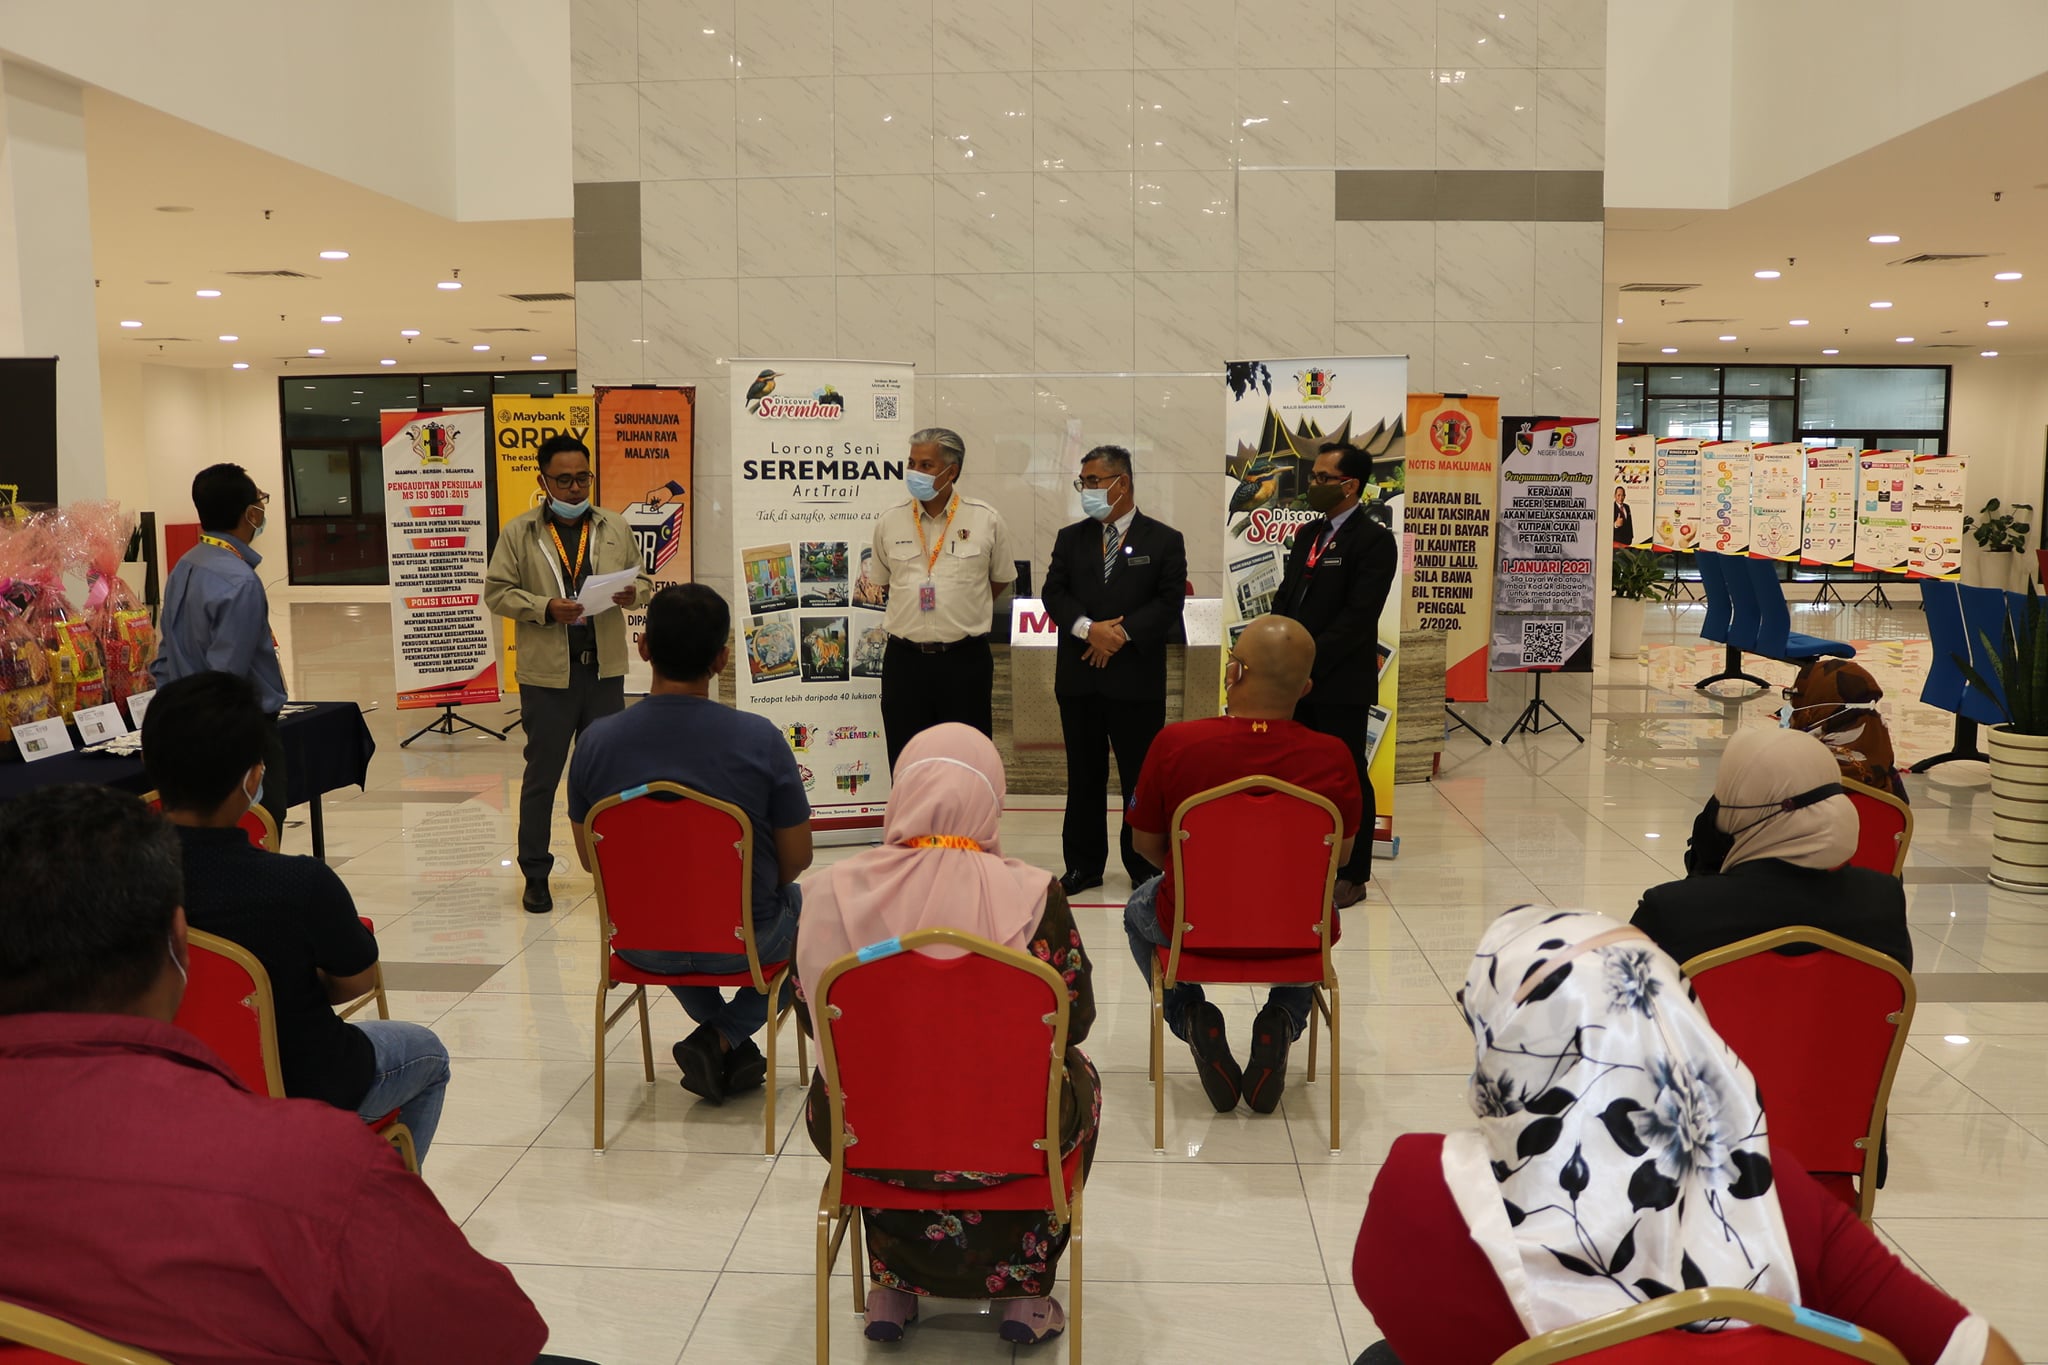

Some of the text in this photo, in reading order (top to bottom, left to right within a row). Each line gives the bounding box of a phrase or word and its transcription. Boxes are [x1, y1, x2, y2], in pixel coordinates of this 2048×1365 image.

[759, 398, 840, 419] Seremban
[513, 412, 565, 423] Maybank
[615, 414, 679, 425] SURUHANJAYA
[617, 431, 677, 442] PILIHAN RAYA
[625, 448, 669, 459] MALAYSIA
[771, 441, 880, 458] Lorong Seni
[743, 460, 903, 480] SEREMBAN
[1409, 460, 1491, 472] NOTIS MAKLUMAN
[1505, 471, 1593, 485] Pengumuman Penting
[1819, 478, 1824, 489] 1
[388, 481, 482, 491] PENGAUDITAN PENSIJILAN
[1528, 487, 1570, 496] KERAJAAN
[403, 490, 468, 499] MS ISO 9001:2015
[1413, 491, 1481, 505] BAYARAN BIL
[1806, 492, 1837, 503] 2 3
[1513, 500, 1584, 508] NEGERI SEMBILAN
[756, 509, 776, 522] Tak
[778, 509, 788, 521] di
[790, 510, 825, 523] sangko,
[829, 512, 858, 521] semuo
[1404, 507, 1490, 520] CUKAI TAKSIRAN
[1504, 511, 1594, 520] AKAN MELAKSANAKAN
[1805, 508, 1836, 519] 4 5
[1404, 523, 1488, 536] BOLEH DI BAYAR
[1518, 523, 1578, 531] KUTIPAN CUKAI
[1805, 523, 1836, 533] 6 7
[430, 539, 448, 547] MISI
[1519, 534, 1576, 542] PETAK STRATA
[1803, 538, 1836, 549] 8 9
[1414, 539, 1475, 552] DI KAUNTER
[1535, 545, 1559, 553] MULAI
[1414, 555, 1478, 568] ANDU LALU.
[1503, 561, 1590, 573] 1 JANUARI 2021
[1414, 571, 1472, 583] SILA BAWA
[1412, 586, 1473, 599] BIL TERKINI
[411, 596, 473, 606] POLISI KUALITI
[1417, 602, 1466, 614] PENGGAL
[1420, 618, 1461, 630] 2/2020.
[750, 696, 782, 704] Terdapat
[805, 694, 838, 703] daripada
